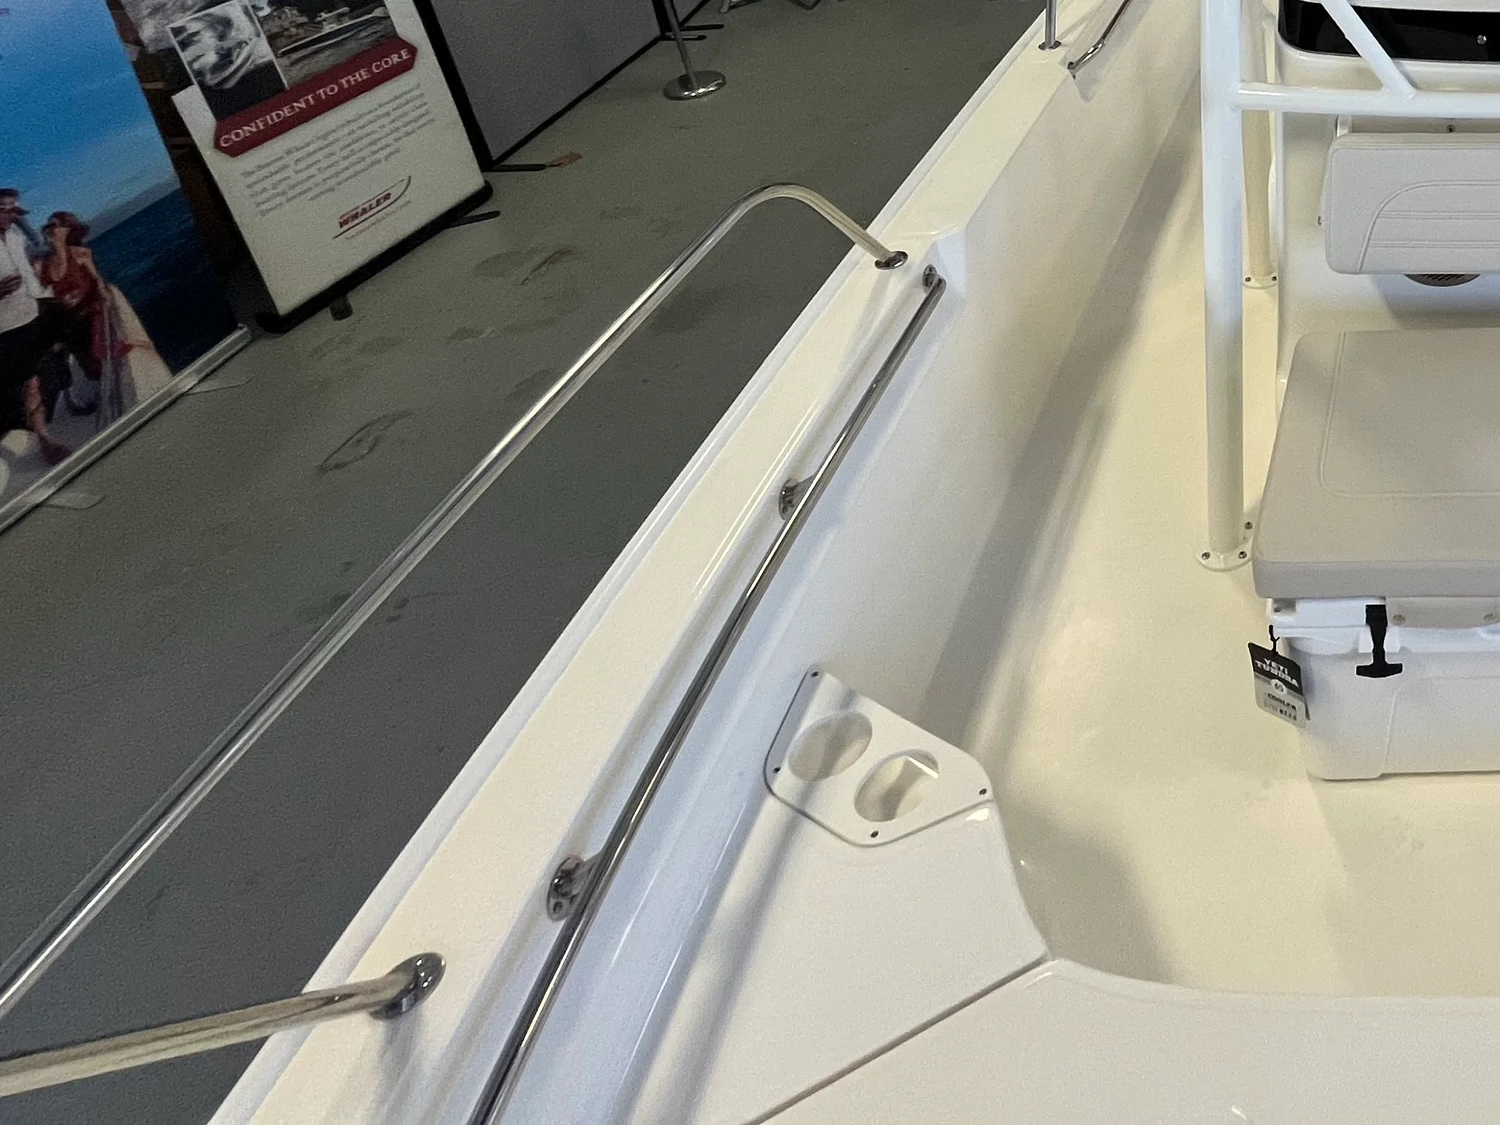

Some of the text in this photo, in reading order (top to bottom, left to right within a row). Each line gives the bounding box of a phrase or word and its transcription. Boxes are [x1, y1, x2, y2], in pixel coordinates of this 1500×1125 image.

[219, 47, 412, 148] CONFIDENT TO THE CORE
[339, 191, 392, 229] WHALER
[1254, 660, 1300, 688] TUNDRA
[1264, 658, 1288, 675] YETI
